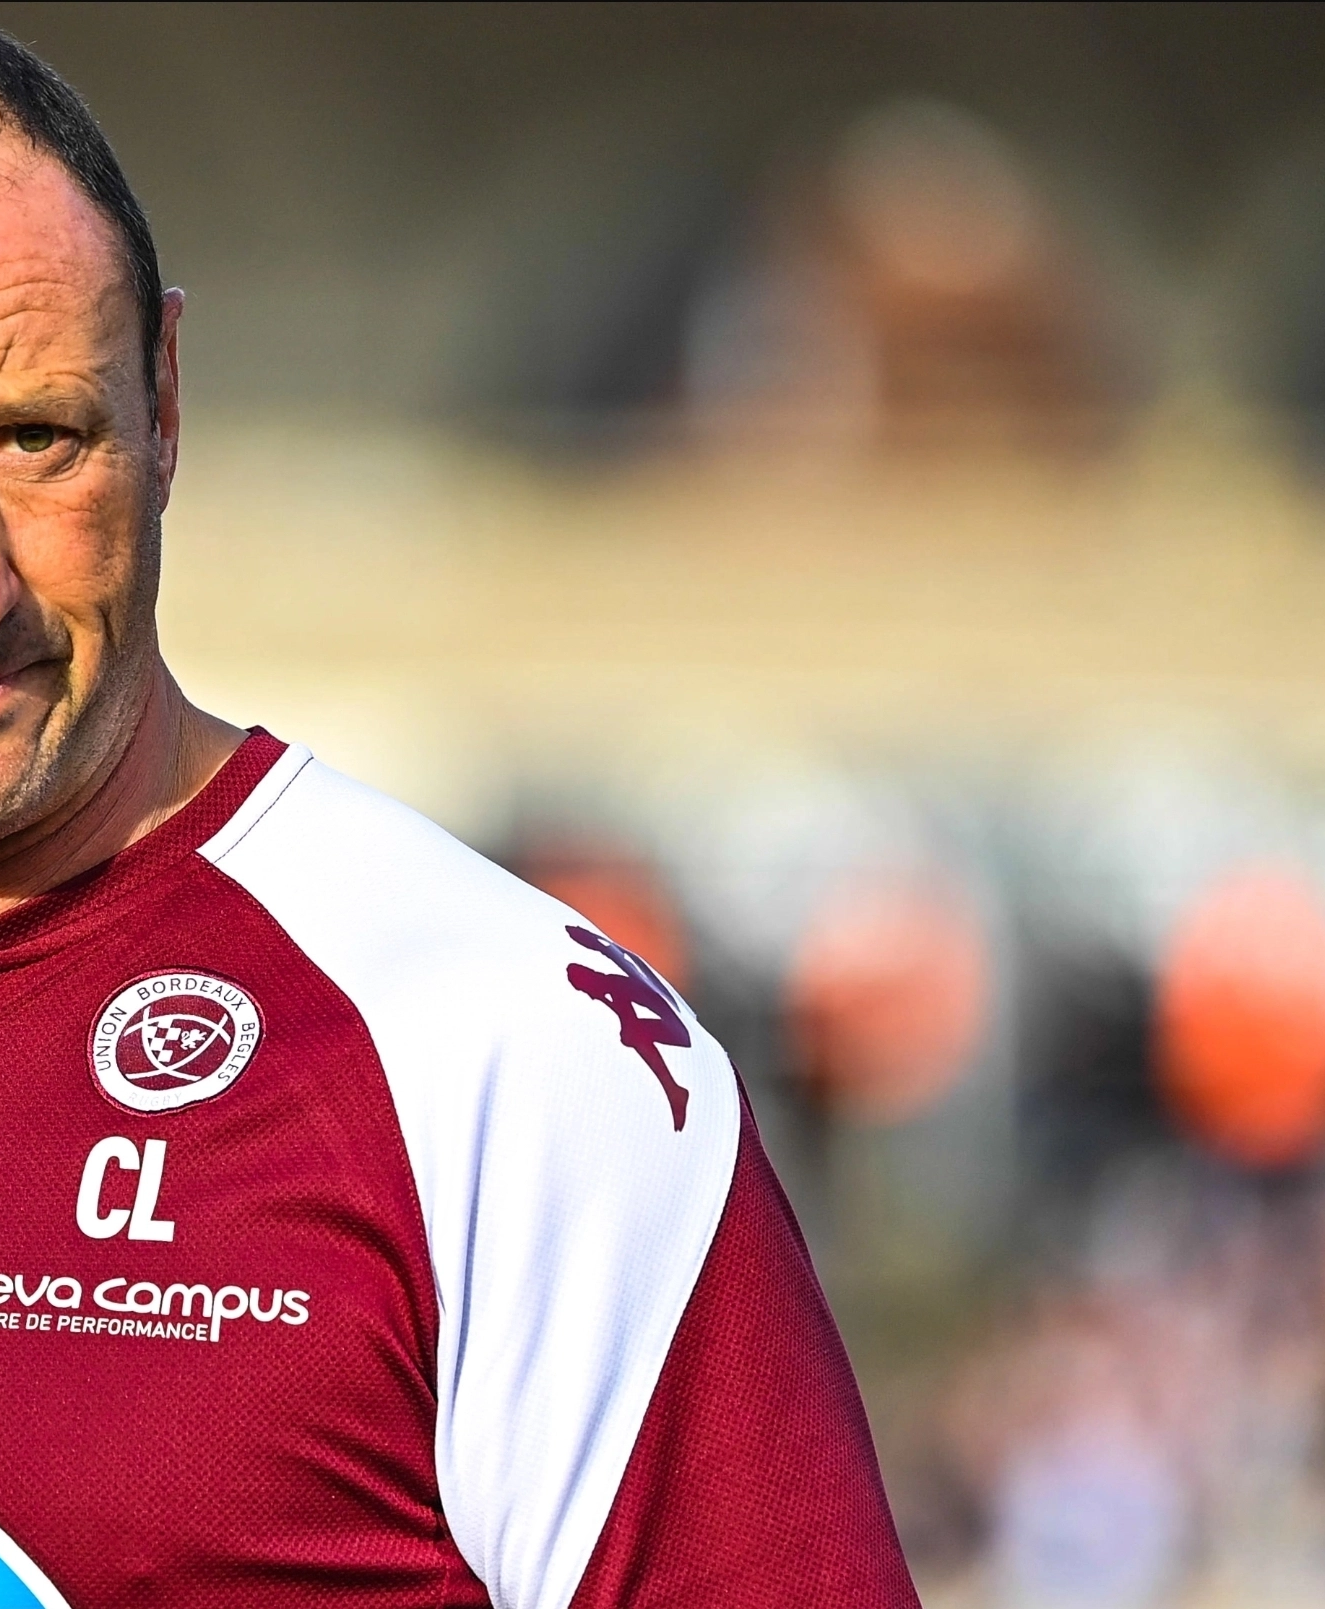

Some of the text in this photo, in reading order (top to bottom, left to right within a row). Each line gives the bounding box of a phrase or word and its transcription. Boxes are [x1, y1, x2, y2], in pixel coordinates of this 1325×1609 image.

[96, 1006, 127, 1072] UNION
[136, 977, 248, 1011] BORDEAUX
[76, 1135, 175, 1242] CL
[25, 1313, 51, 1331] DE
[56, 1315, 209, 1342] PERFORMANCE
